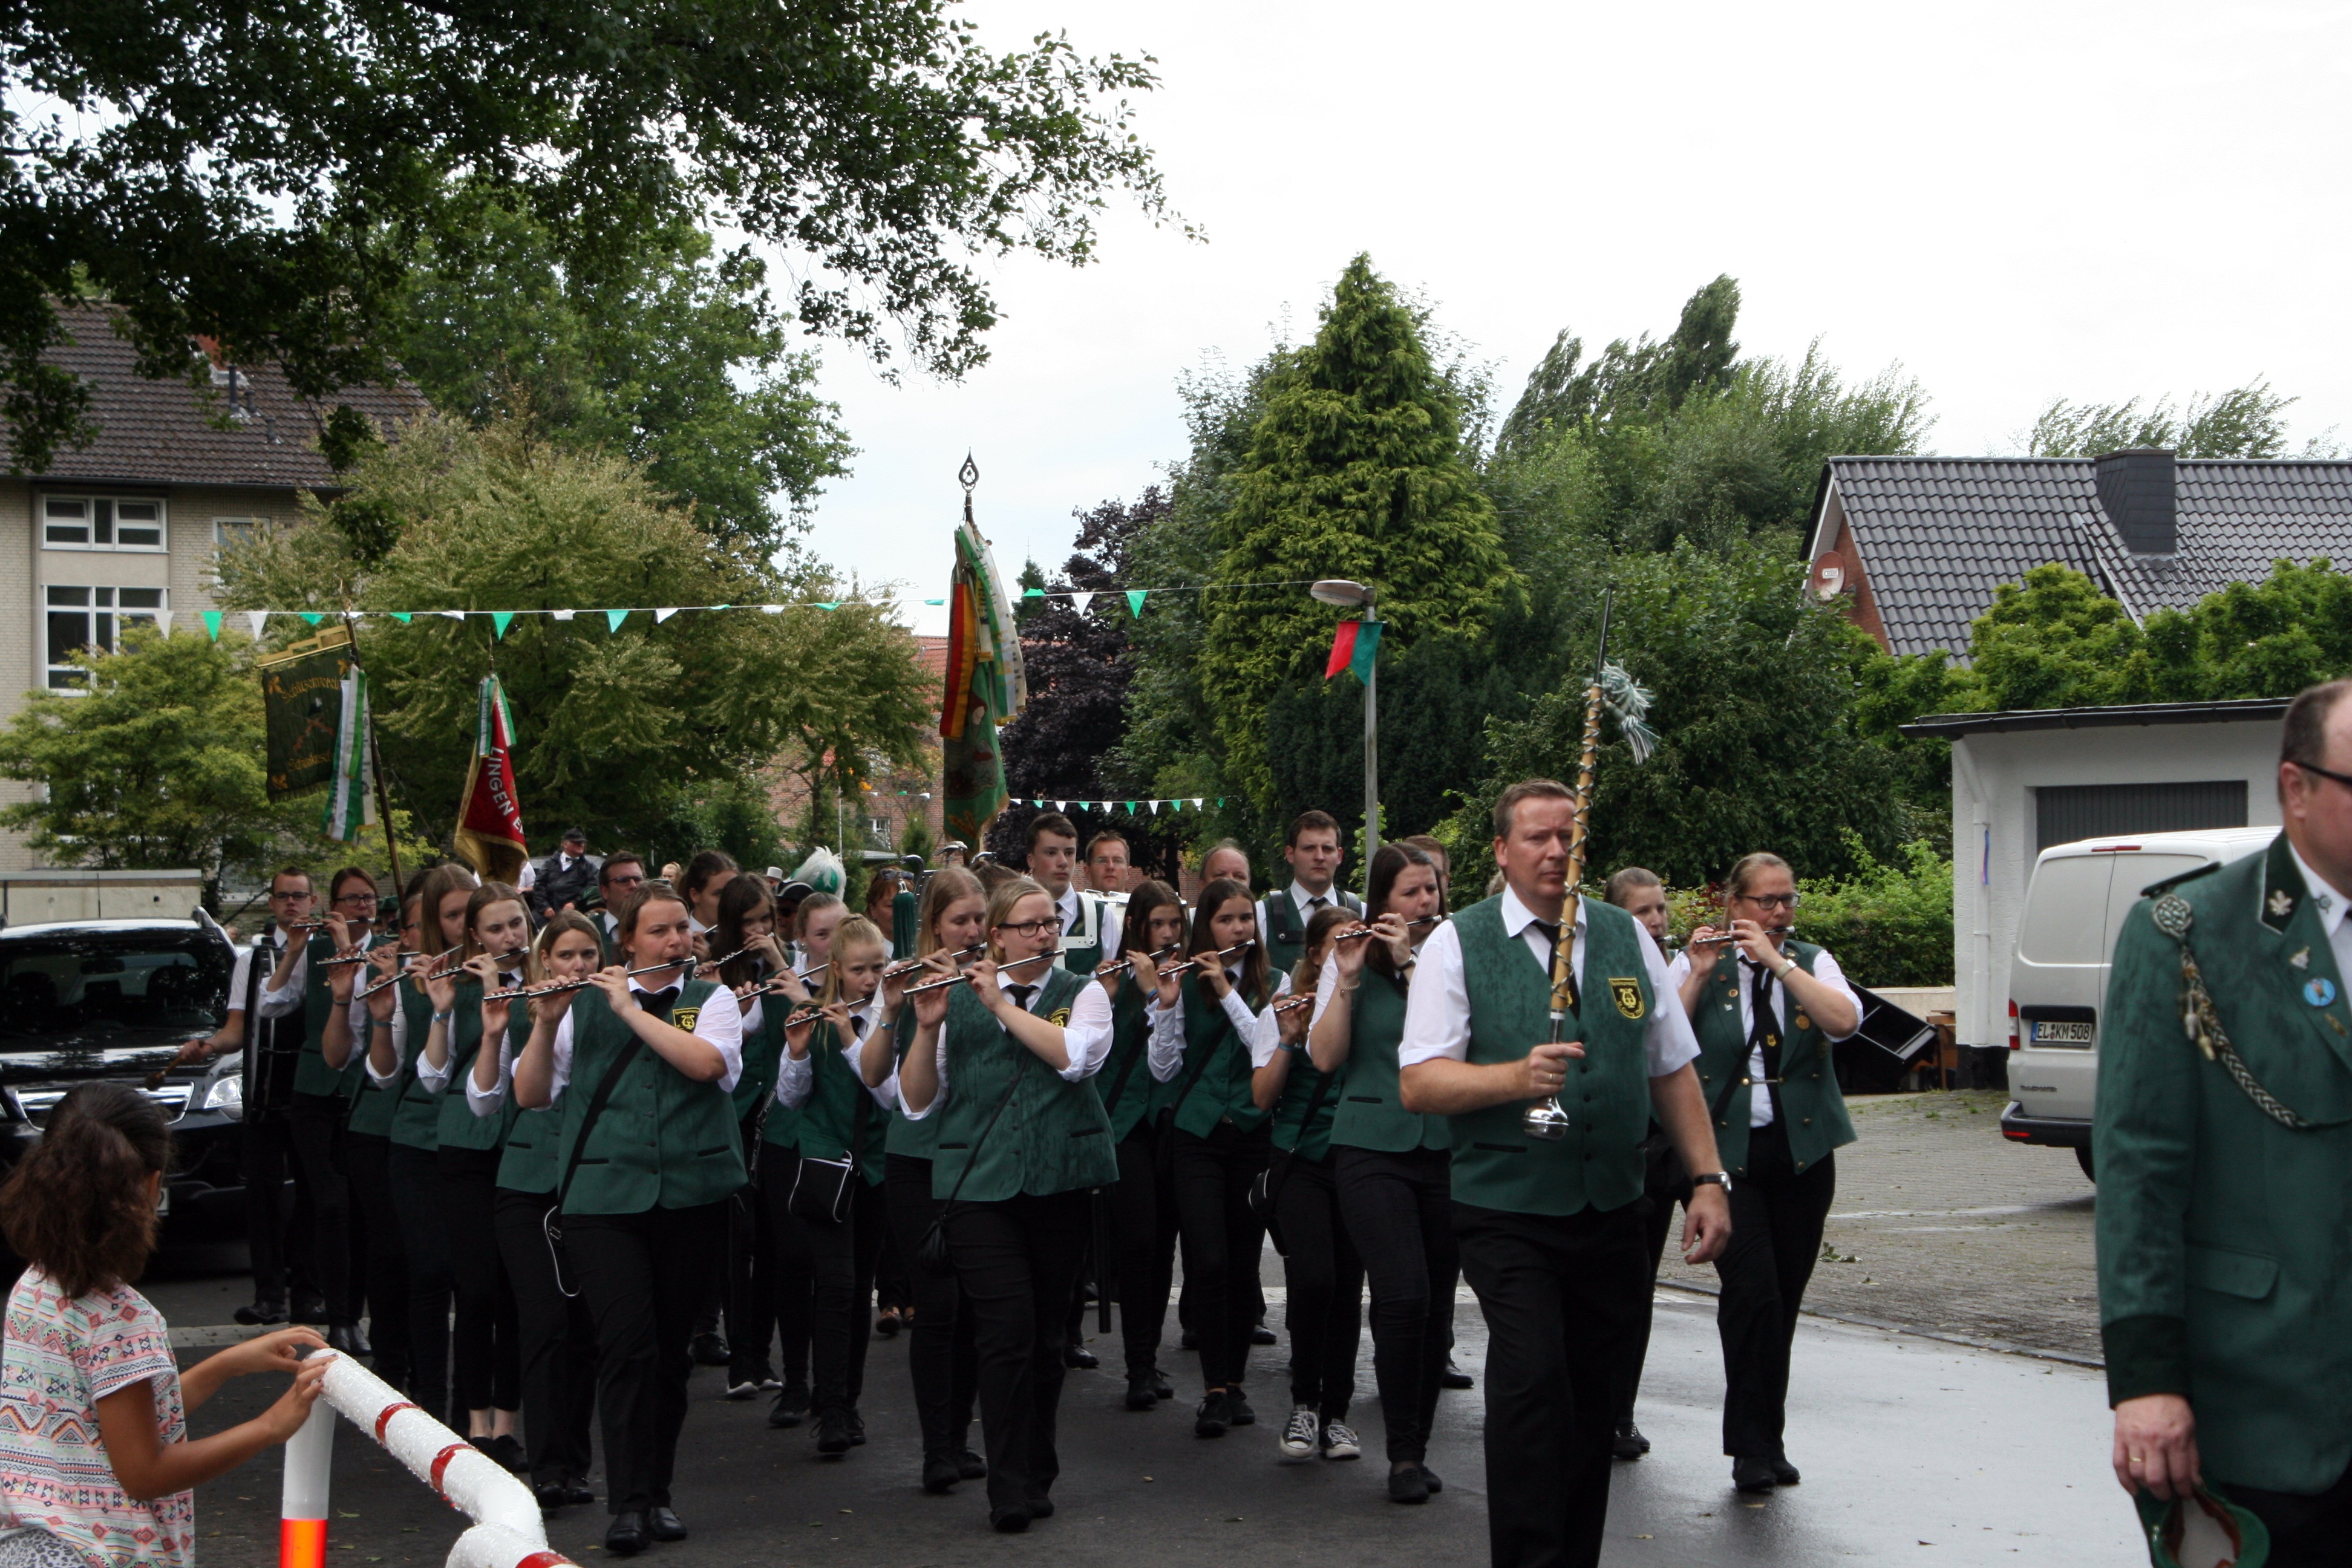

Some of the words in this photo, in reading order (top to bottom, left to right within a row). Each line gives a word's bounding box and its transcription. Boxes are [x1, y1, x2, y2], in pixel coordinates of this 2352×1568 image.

[488, 746, 514, 816] LINGEN
[2037, 1024, 2050, 1039] EL
[2056, 1024, 2069, 1039] KM
[2070, 1024, 2090, 1040] 508
